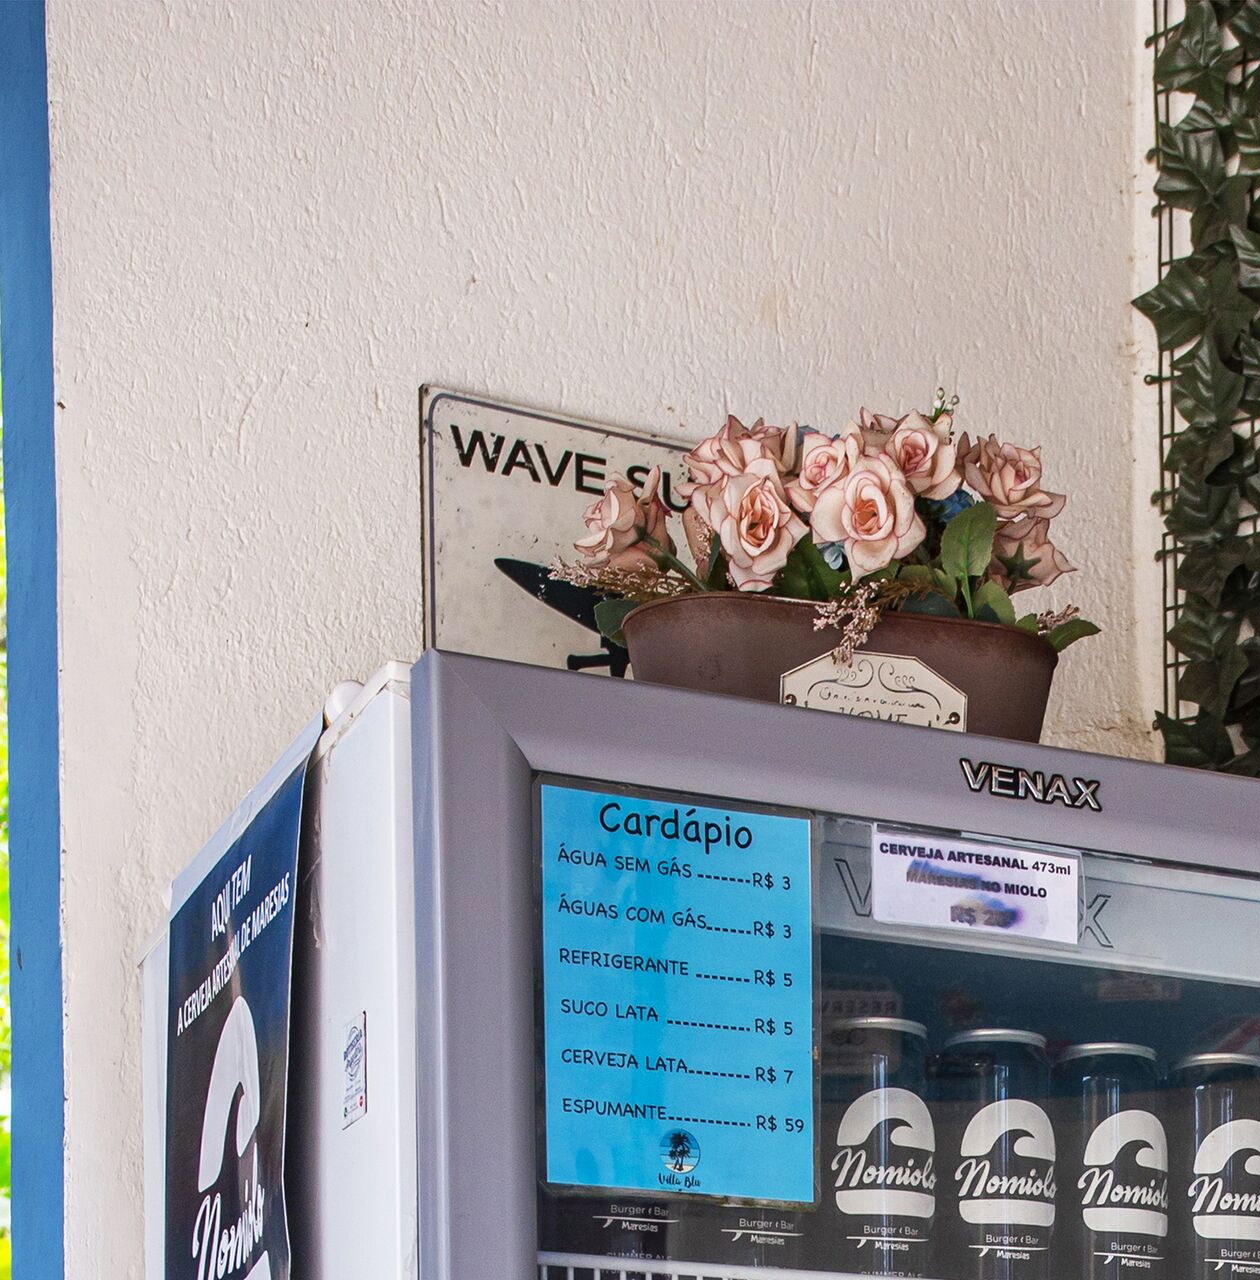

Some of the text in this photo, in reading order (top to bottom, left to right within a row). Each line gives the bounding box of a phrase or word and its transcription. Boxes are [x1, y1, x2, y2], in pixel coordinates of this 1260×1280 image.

[450, 424, 692, 513] WAVE SU
[959, 758, 1102, 812] VENAX
[599, 802, 753, 855] Cardápio
[557, 843, 792, 891] ÁGUA SEM GÁS R$ 3
[879, 841, 1072, 876] CERVEJA ARTESANAL 473ml
[211, 854, 252, 942] AQUI TEM
[982, 878, 1001, 893] NO
[1004, 883, 1047, 899] MIOLO
[558, 893, 619, 920] ÁGUAS
[626, 906, 666, 925] COM
[753, 921, 776, 940] R$
[783, 925, 793, 940] 3
[177, 870, 290, 1036] A CERVEJA ARTESANAL DE MARESIAS
[559, 948, 793, 989] REFRIGERANTE R$ 5
[560, 999, 794, 1037] SUCO LATA R$ 5
[561, 1049, 639, 1070] CERVEJA
[755, 1067, 778, 1085] R$
[784, 1069, 794, 1085] 7
[562, 1098, 805, 1134] ESPUMANTE R$ 59
[1110, 1242, 1141, 1254] Burger
[1220, 1248, 1251, 1260] Burger
